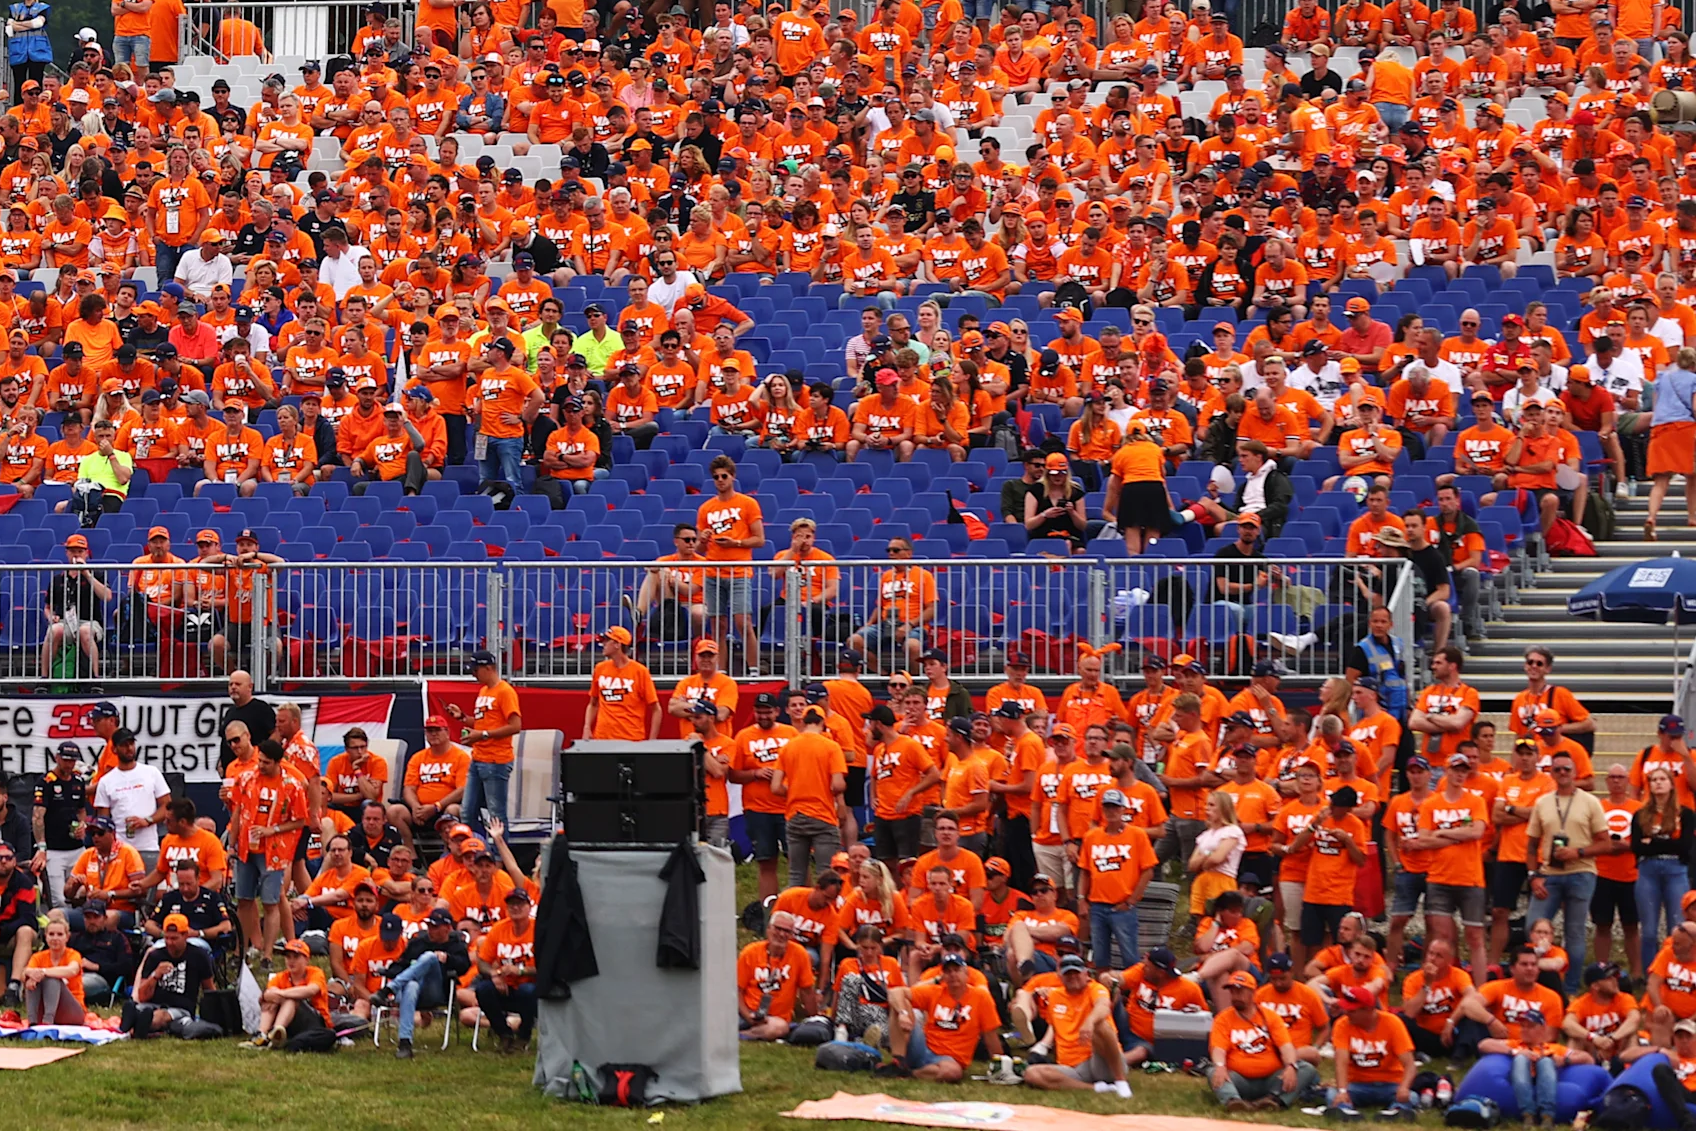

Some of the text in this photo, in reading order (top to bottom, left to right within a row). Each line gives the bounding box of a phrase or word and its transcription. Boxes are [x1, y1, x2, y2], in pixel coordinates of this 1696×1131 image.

[782, 21, 811, 33] MAX
[1206, 50, 1230, 62] MAX
[417, 102, 443, 113] MAX
[782, 145, 810, 157] MAX
[53, 232, 76, 243] MAX
[932, 250, 960, 259] MAX
[963, 258, 987, 270] MAX
[1175, 256, 1206, 266] MAX
[854, 262, 883, 277] MAX
[1069, 264, 1098, 276] MAX
[507, 293, 538, 305] MAX
[296, 356, 323, 371] MAX
[430, 352, 459, 364] MAX
[342, 366, 371, 377] MAX
[481, 379, 507, 390] MAX
[653, 375, 683, 385] MAX
[718, 401, 748, 414] MAX
[1406, 400, 1438, 411] MAX
[869, 415, 899, 428] MAX
[376, 443, 402, 455] MAX
[1466, 440, 1500, 451] MAX
[708, 508, 740, 522] MAX
[599, 676, 633, 691] MAX
[750, 738, 789, 753] MAX
[420, 763, 451, 774] MAX
[1073, 774, 1112, 789] MAX
[166, 847, 199, 862] MAX
[1092, 845, 1131, 861] MAX
[498, 943, 533, 958] MAX
[1351, 1039, 1386, 1054] MAX
